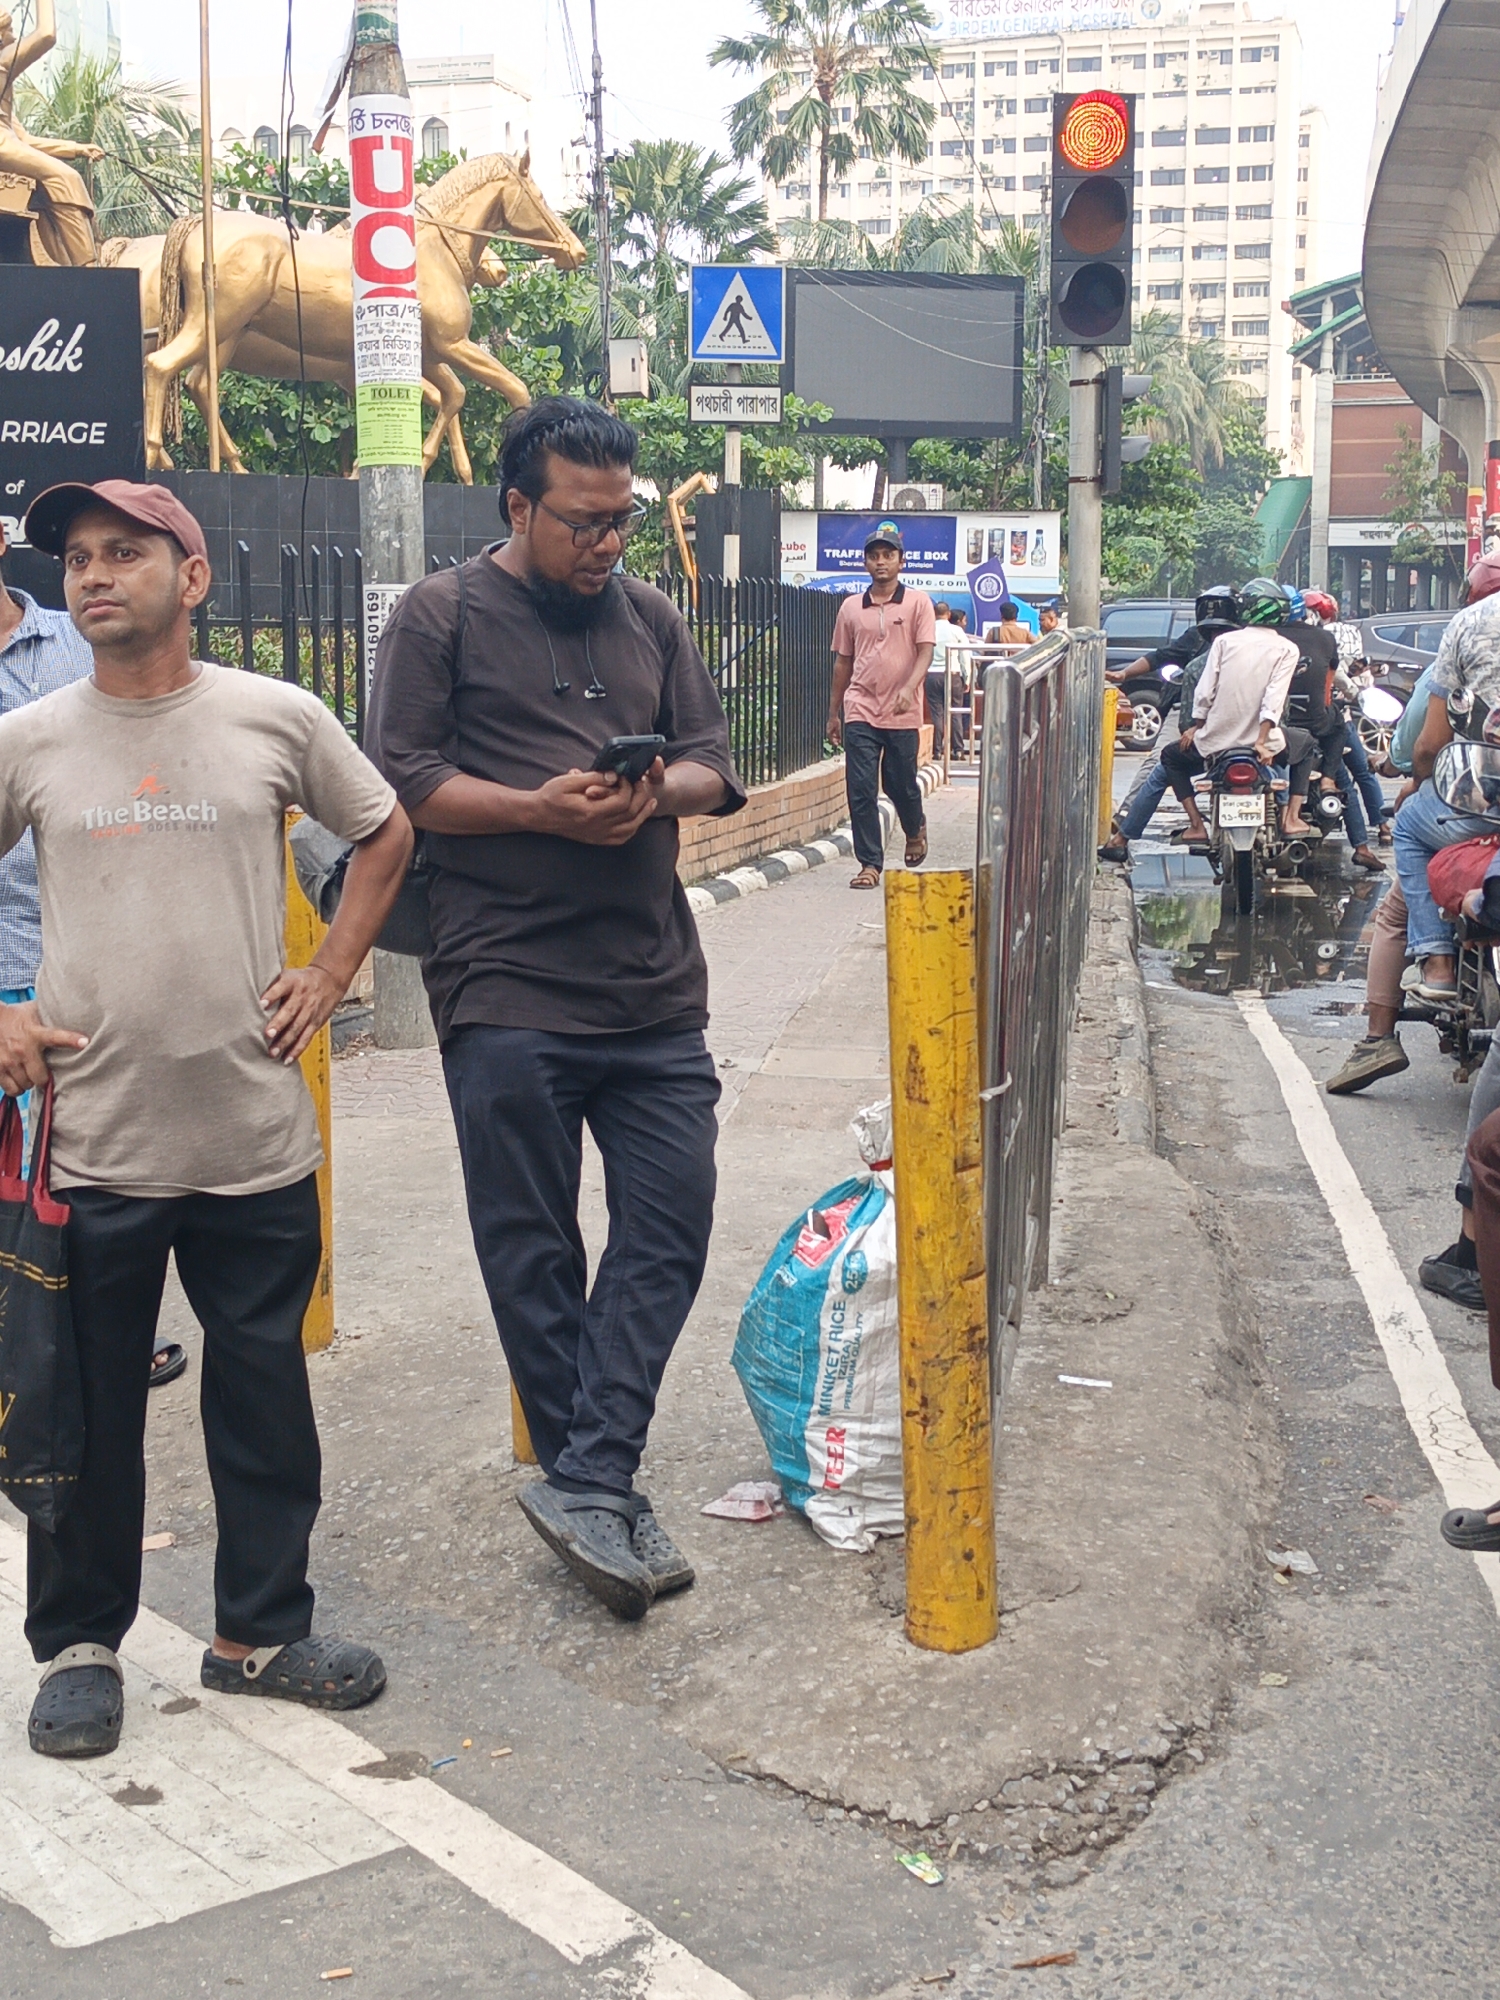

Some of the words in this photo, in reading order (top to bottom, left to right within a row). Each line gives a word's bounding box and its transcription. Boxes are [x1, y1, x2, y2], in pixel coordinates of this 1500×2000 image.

[949, 20, 1000, 35] BIRDEM
[1003, 16, 1066, 33] GENERAL
[371, 387, 411, 400] TOLET
[695, 389, 733, 415] পথচারী
[736, 394, 778, 415] পারাপার
[5, 479, 25, 495] of
[824, 549, 865, 559] TRAFFI
[924, 551, 949, 562] BOX
[80, 805, 130, 831] The
[134, 799, 218, 822] Beach
[845, 1269, 859, 1290] 25
[828, 1300, 847, 1342] RICE
[851, 1311, 864, 1358] QUALITY
[818, 1345, 841, 1417] MINIKET
[844, 1359, 859, 1410] PREMIUM
[822, 1426, 846, 1490] TEER
